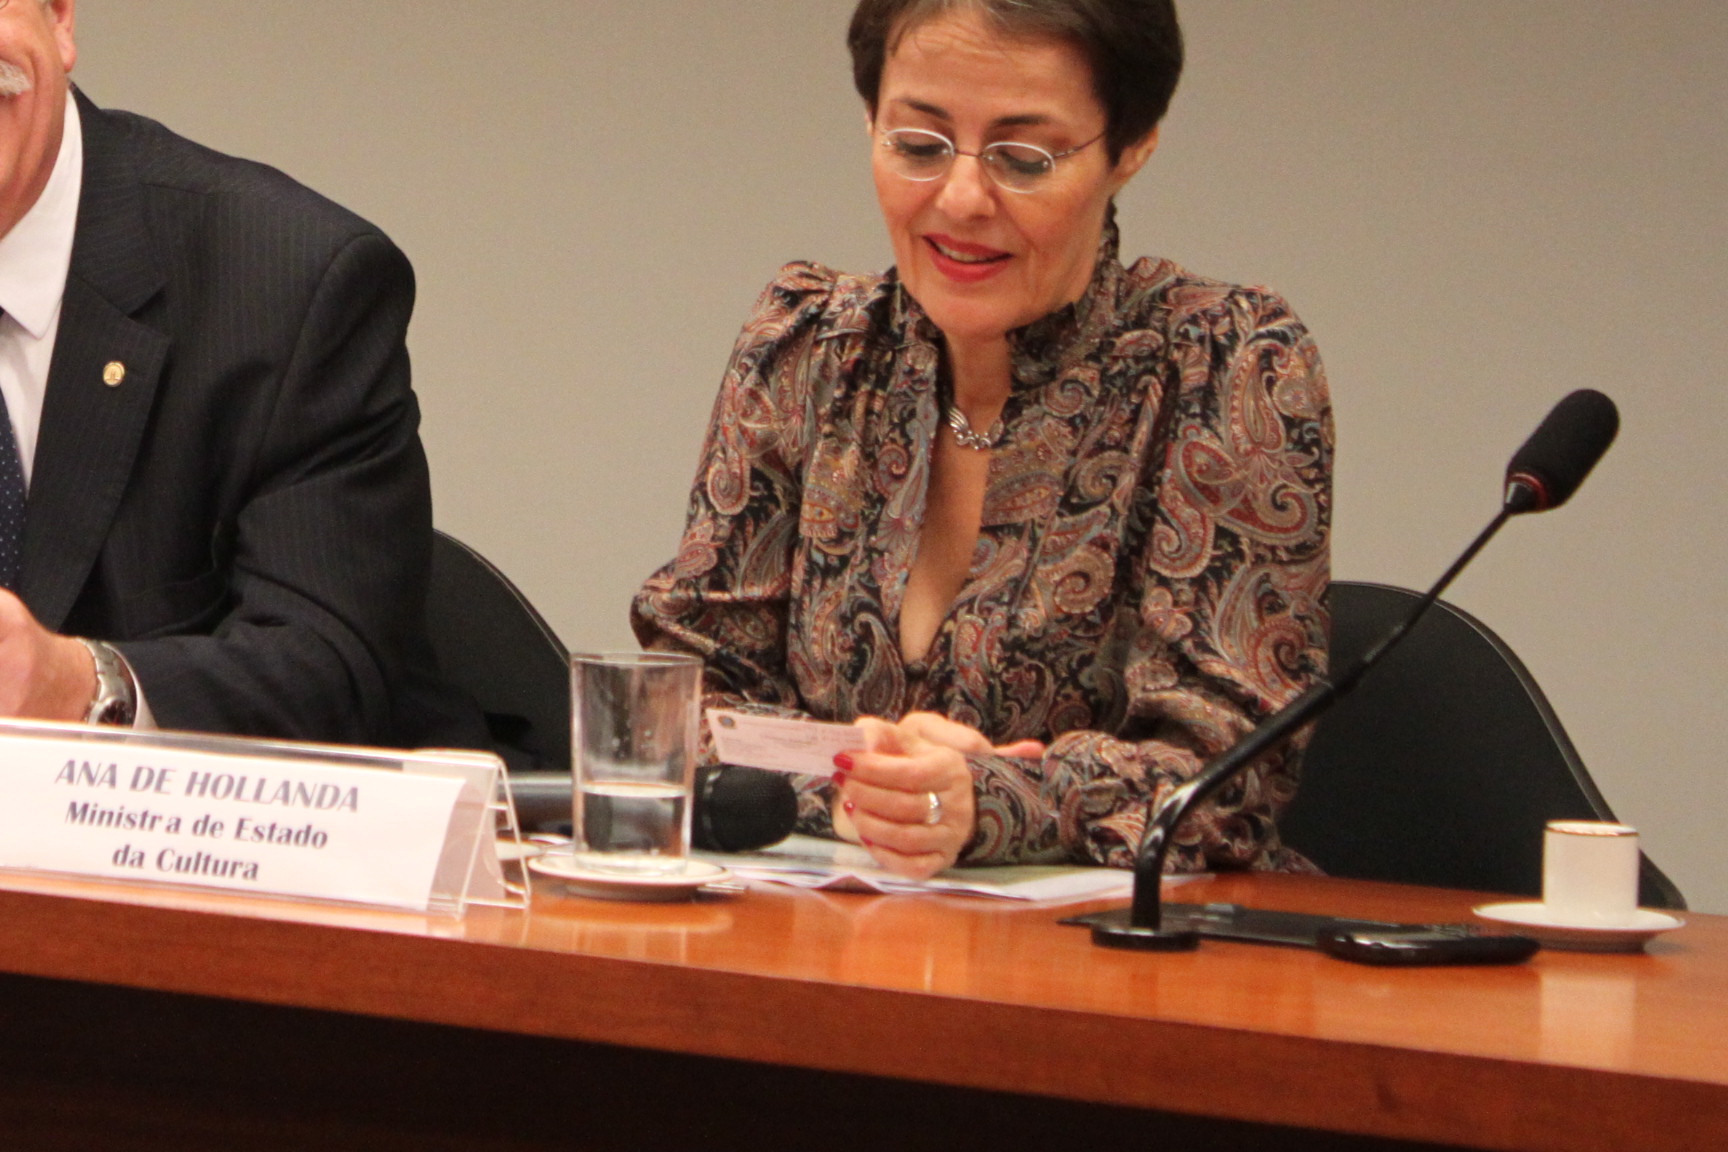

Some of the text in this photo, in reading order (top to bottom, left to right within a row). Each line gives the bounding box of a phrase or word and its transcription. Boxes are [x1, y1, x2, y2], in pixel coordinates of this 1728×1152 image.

[55, 759, 359, 813] ANA DE HOLLANDA
[64, 800, 328, 849] Ministra de Estado
[111, 843, 259, 882] da Cultura
